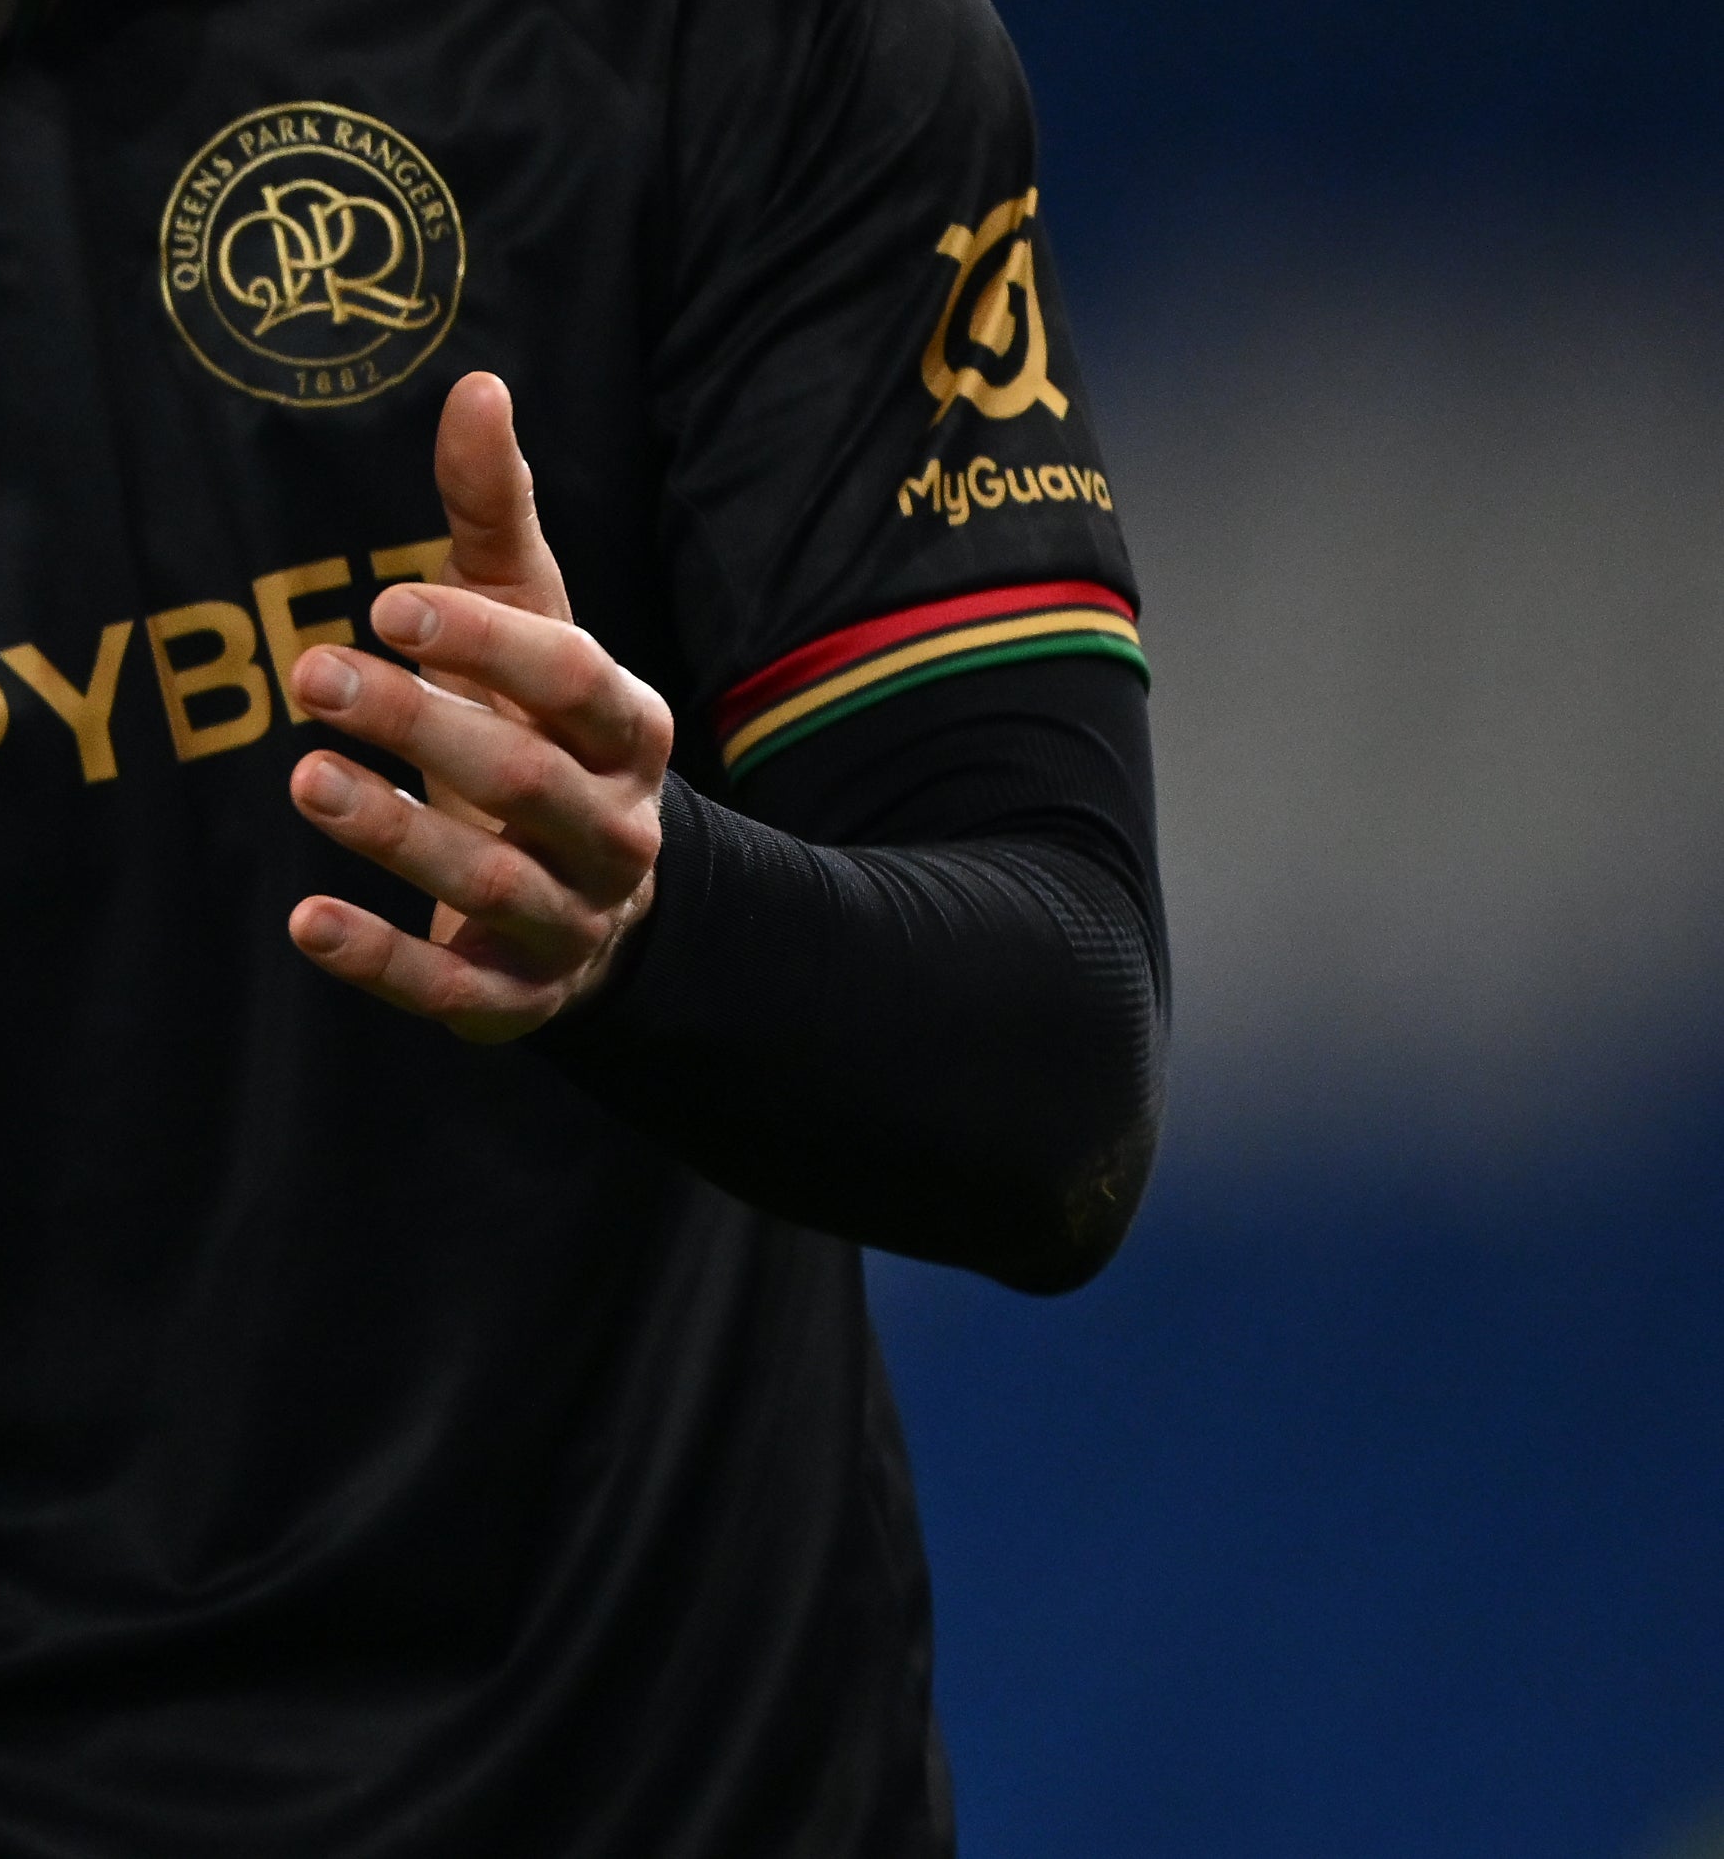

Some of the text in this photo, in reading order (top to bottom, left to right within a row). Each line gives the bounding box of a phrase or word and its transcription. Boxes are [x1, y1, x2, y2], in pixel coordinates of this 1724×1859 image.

[172, 115, 453, 292] QUEENS PARK RANGERS
[897, 454, 1114, 527] MyGuava
